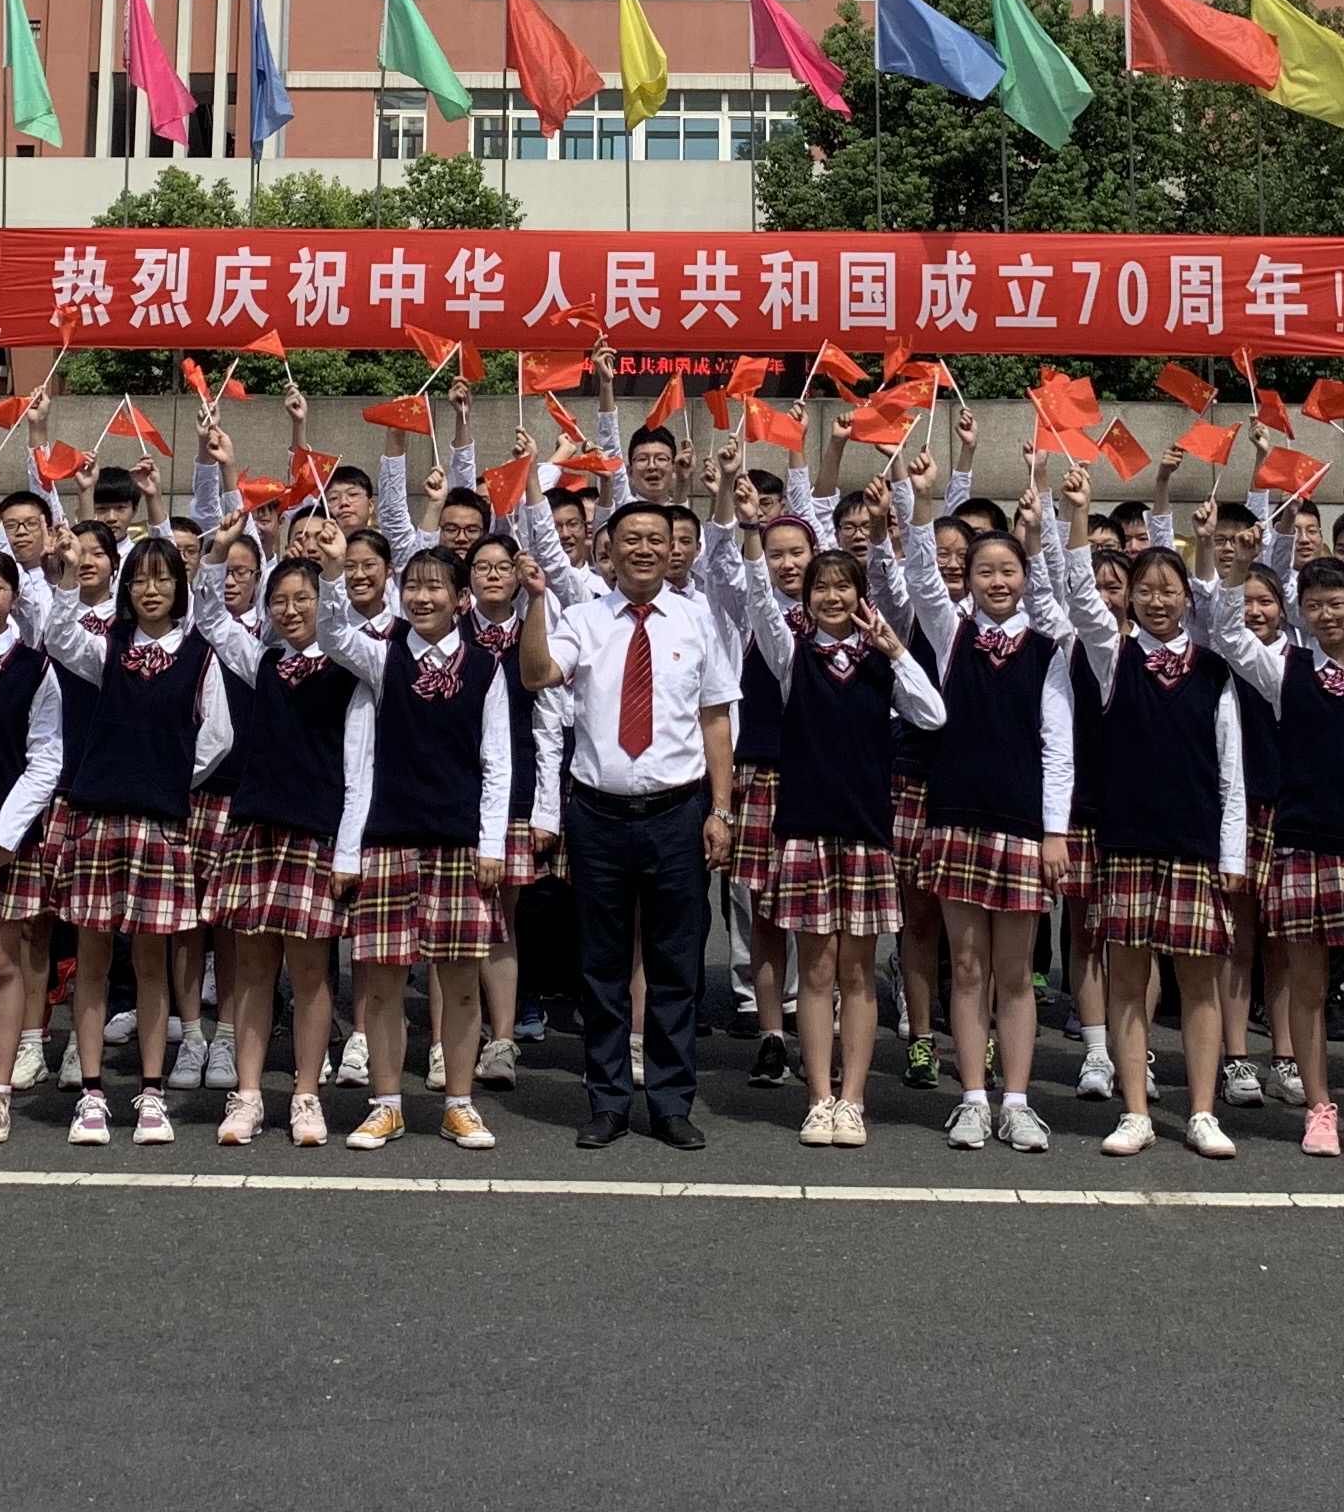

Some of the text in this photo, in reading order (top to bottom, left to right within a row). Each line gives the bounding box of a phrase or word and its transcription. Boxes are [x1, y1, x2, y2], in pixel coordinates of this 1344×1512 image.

[49, 246, 1344, 335] 热烈庆祝中华人民共和国成立70周年！
